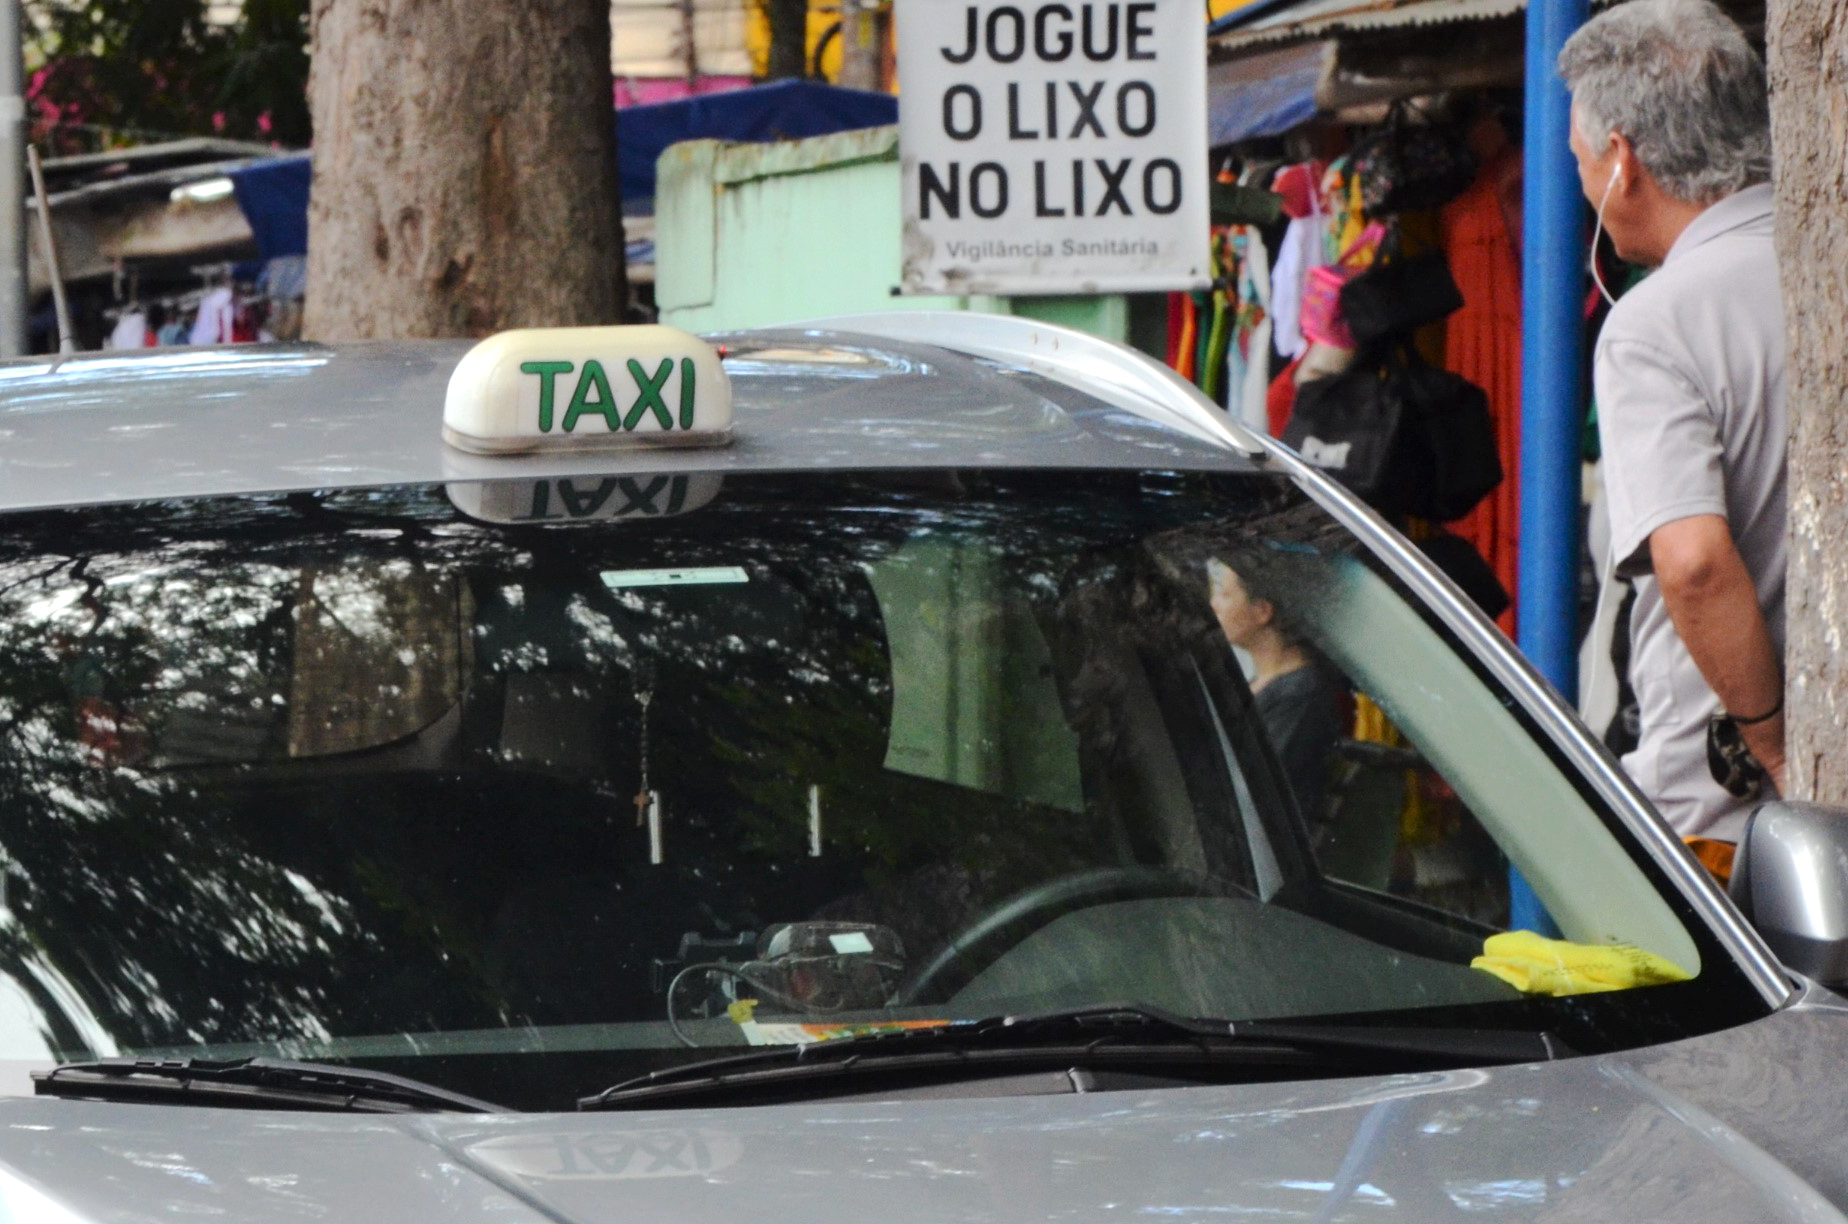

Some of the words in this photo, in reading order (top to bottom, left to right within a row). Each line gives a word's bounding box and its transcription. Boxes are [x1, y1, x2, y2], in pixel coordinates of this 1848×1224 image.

[940, 3, 1157, 64] JOGUE
[942, 83, 982, 141] O
[1008, 80, 1156, 140] LIXO
[918, 161, 1009, 220] NO
[1034, 157, 1183, 217] LIXO
[519, 357, 696, 433] TAXI
